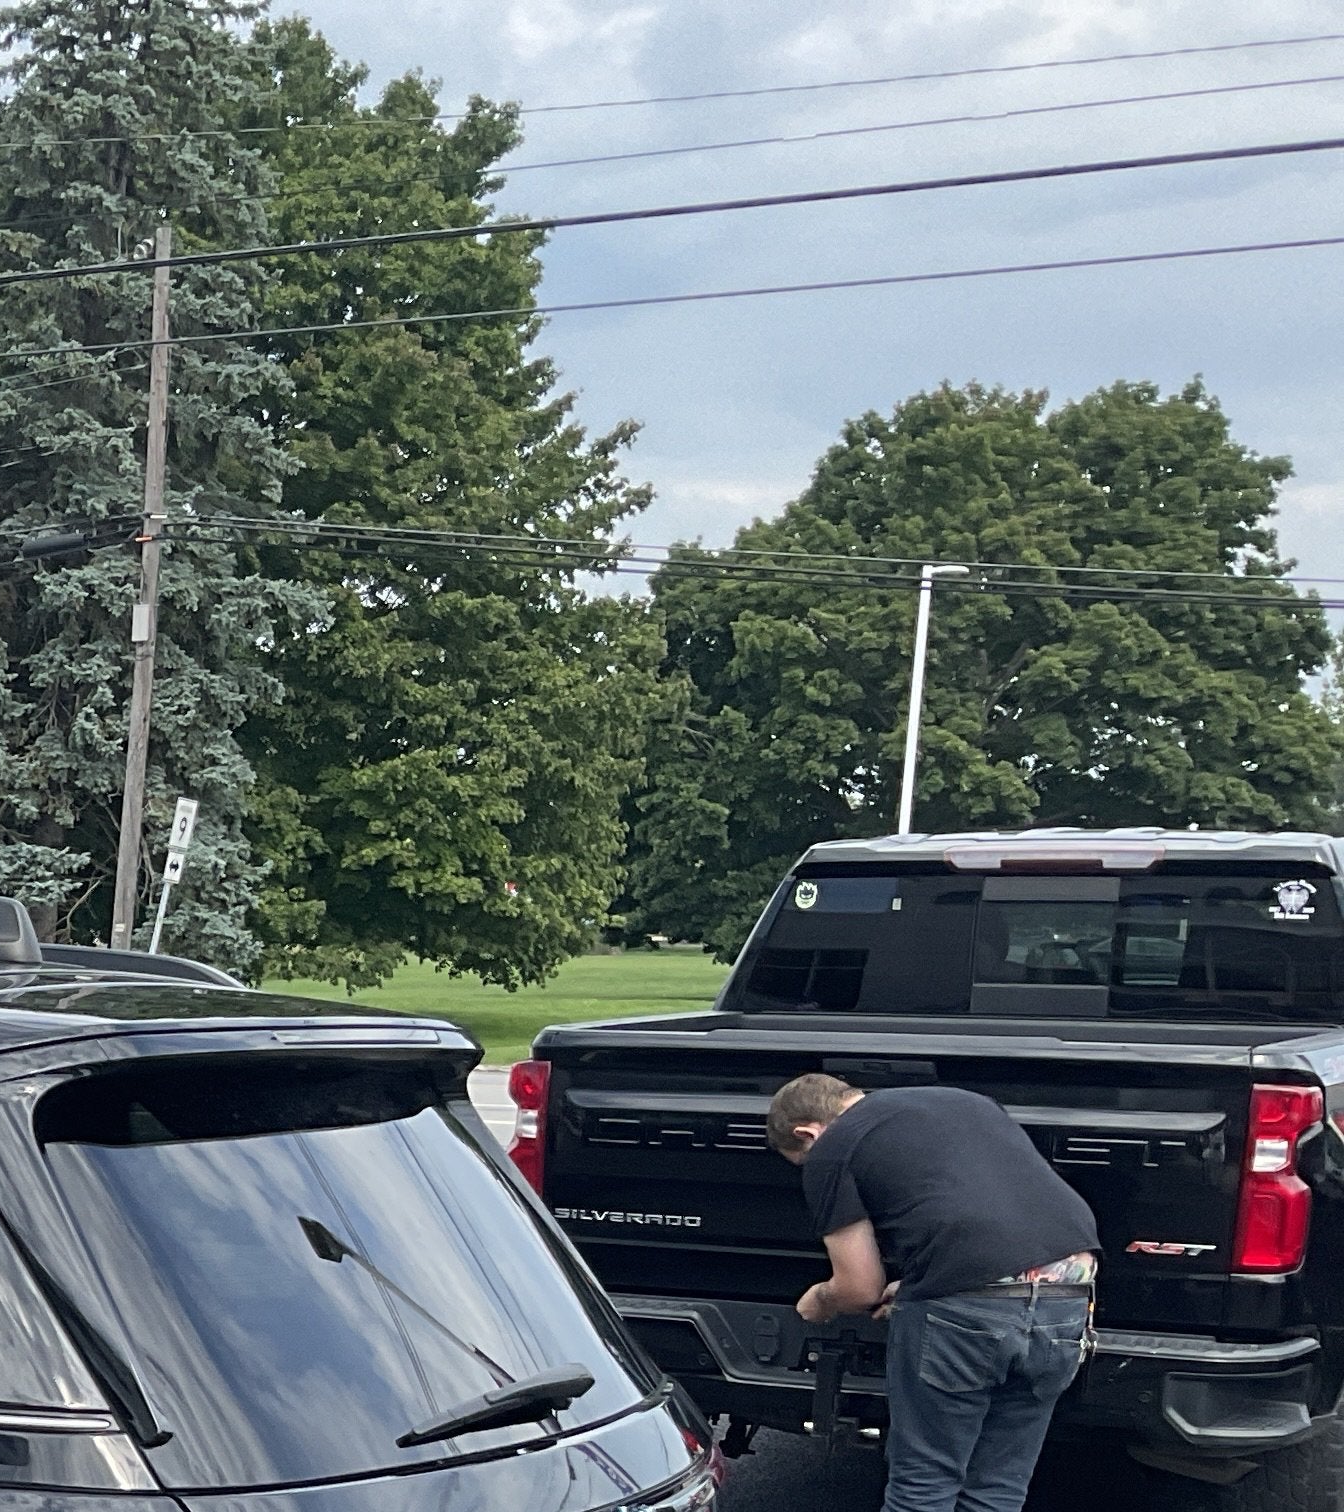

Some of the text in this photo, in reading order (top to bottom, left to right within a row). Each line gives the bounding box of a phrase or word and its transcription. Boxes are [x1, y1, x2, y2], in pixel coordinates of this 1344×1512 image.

[179, 816, 188, 841] 9
[554, 1207, 702, 1227] SILVERADO
[1125, 1240, 1217, 1257] RST
